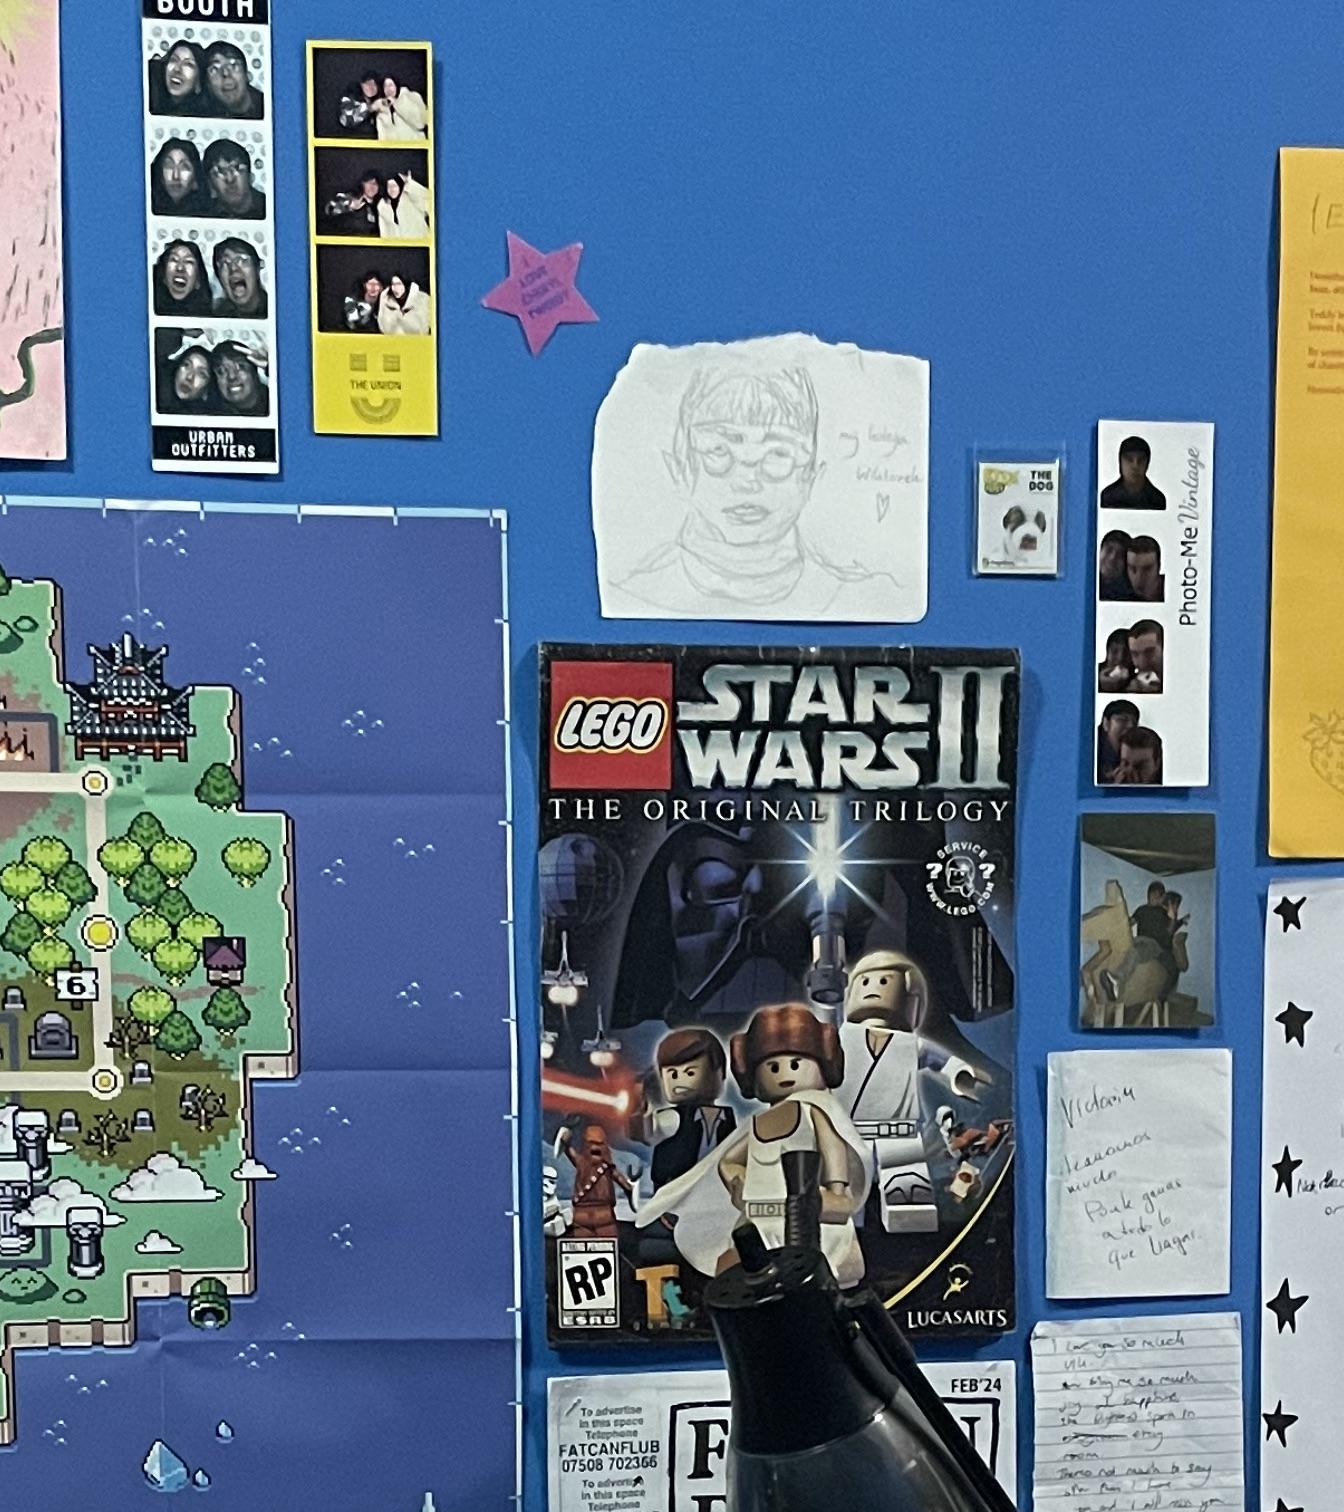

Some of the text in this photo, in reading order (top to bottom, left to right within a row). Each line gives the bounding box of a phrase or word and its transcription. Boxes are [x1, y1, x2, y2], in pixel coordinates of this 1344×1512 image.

[350, 379, 368, 390] THE
[189, 431, 234, 444] URBAN
[171, 443, 256, 459] OUTFITTERS
[1030, 470, 1053, 480] THE
[1029, 481, 1054, 491] DOG
[1178, 446, 1205, 627] Photo-Me Vintage
[559, 664, 1016, 790] LEGO STAR II
[677, 730, 929, 789] WARS
[550, 799, 1010, 822] THE ORIGINAL TRILOGY
[937, 842, 988, 859] SERVICE
[65, 975, 87, 997] 6
[565, 1257, 613, 1306] RP
[907, 1308, 1008, 1329] LUCASARTS
[950, 1377, 1002, 1394] FEB'24
[581, 1406, 593, 1417] To
[558, 1440, 660, 1457] FATCANFLUB
[562, 1455, 658, 1473] 07508 702366
[582, 1479, 594, 1489] To
